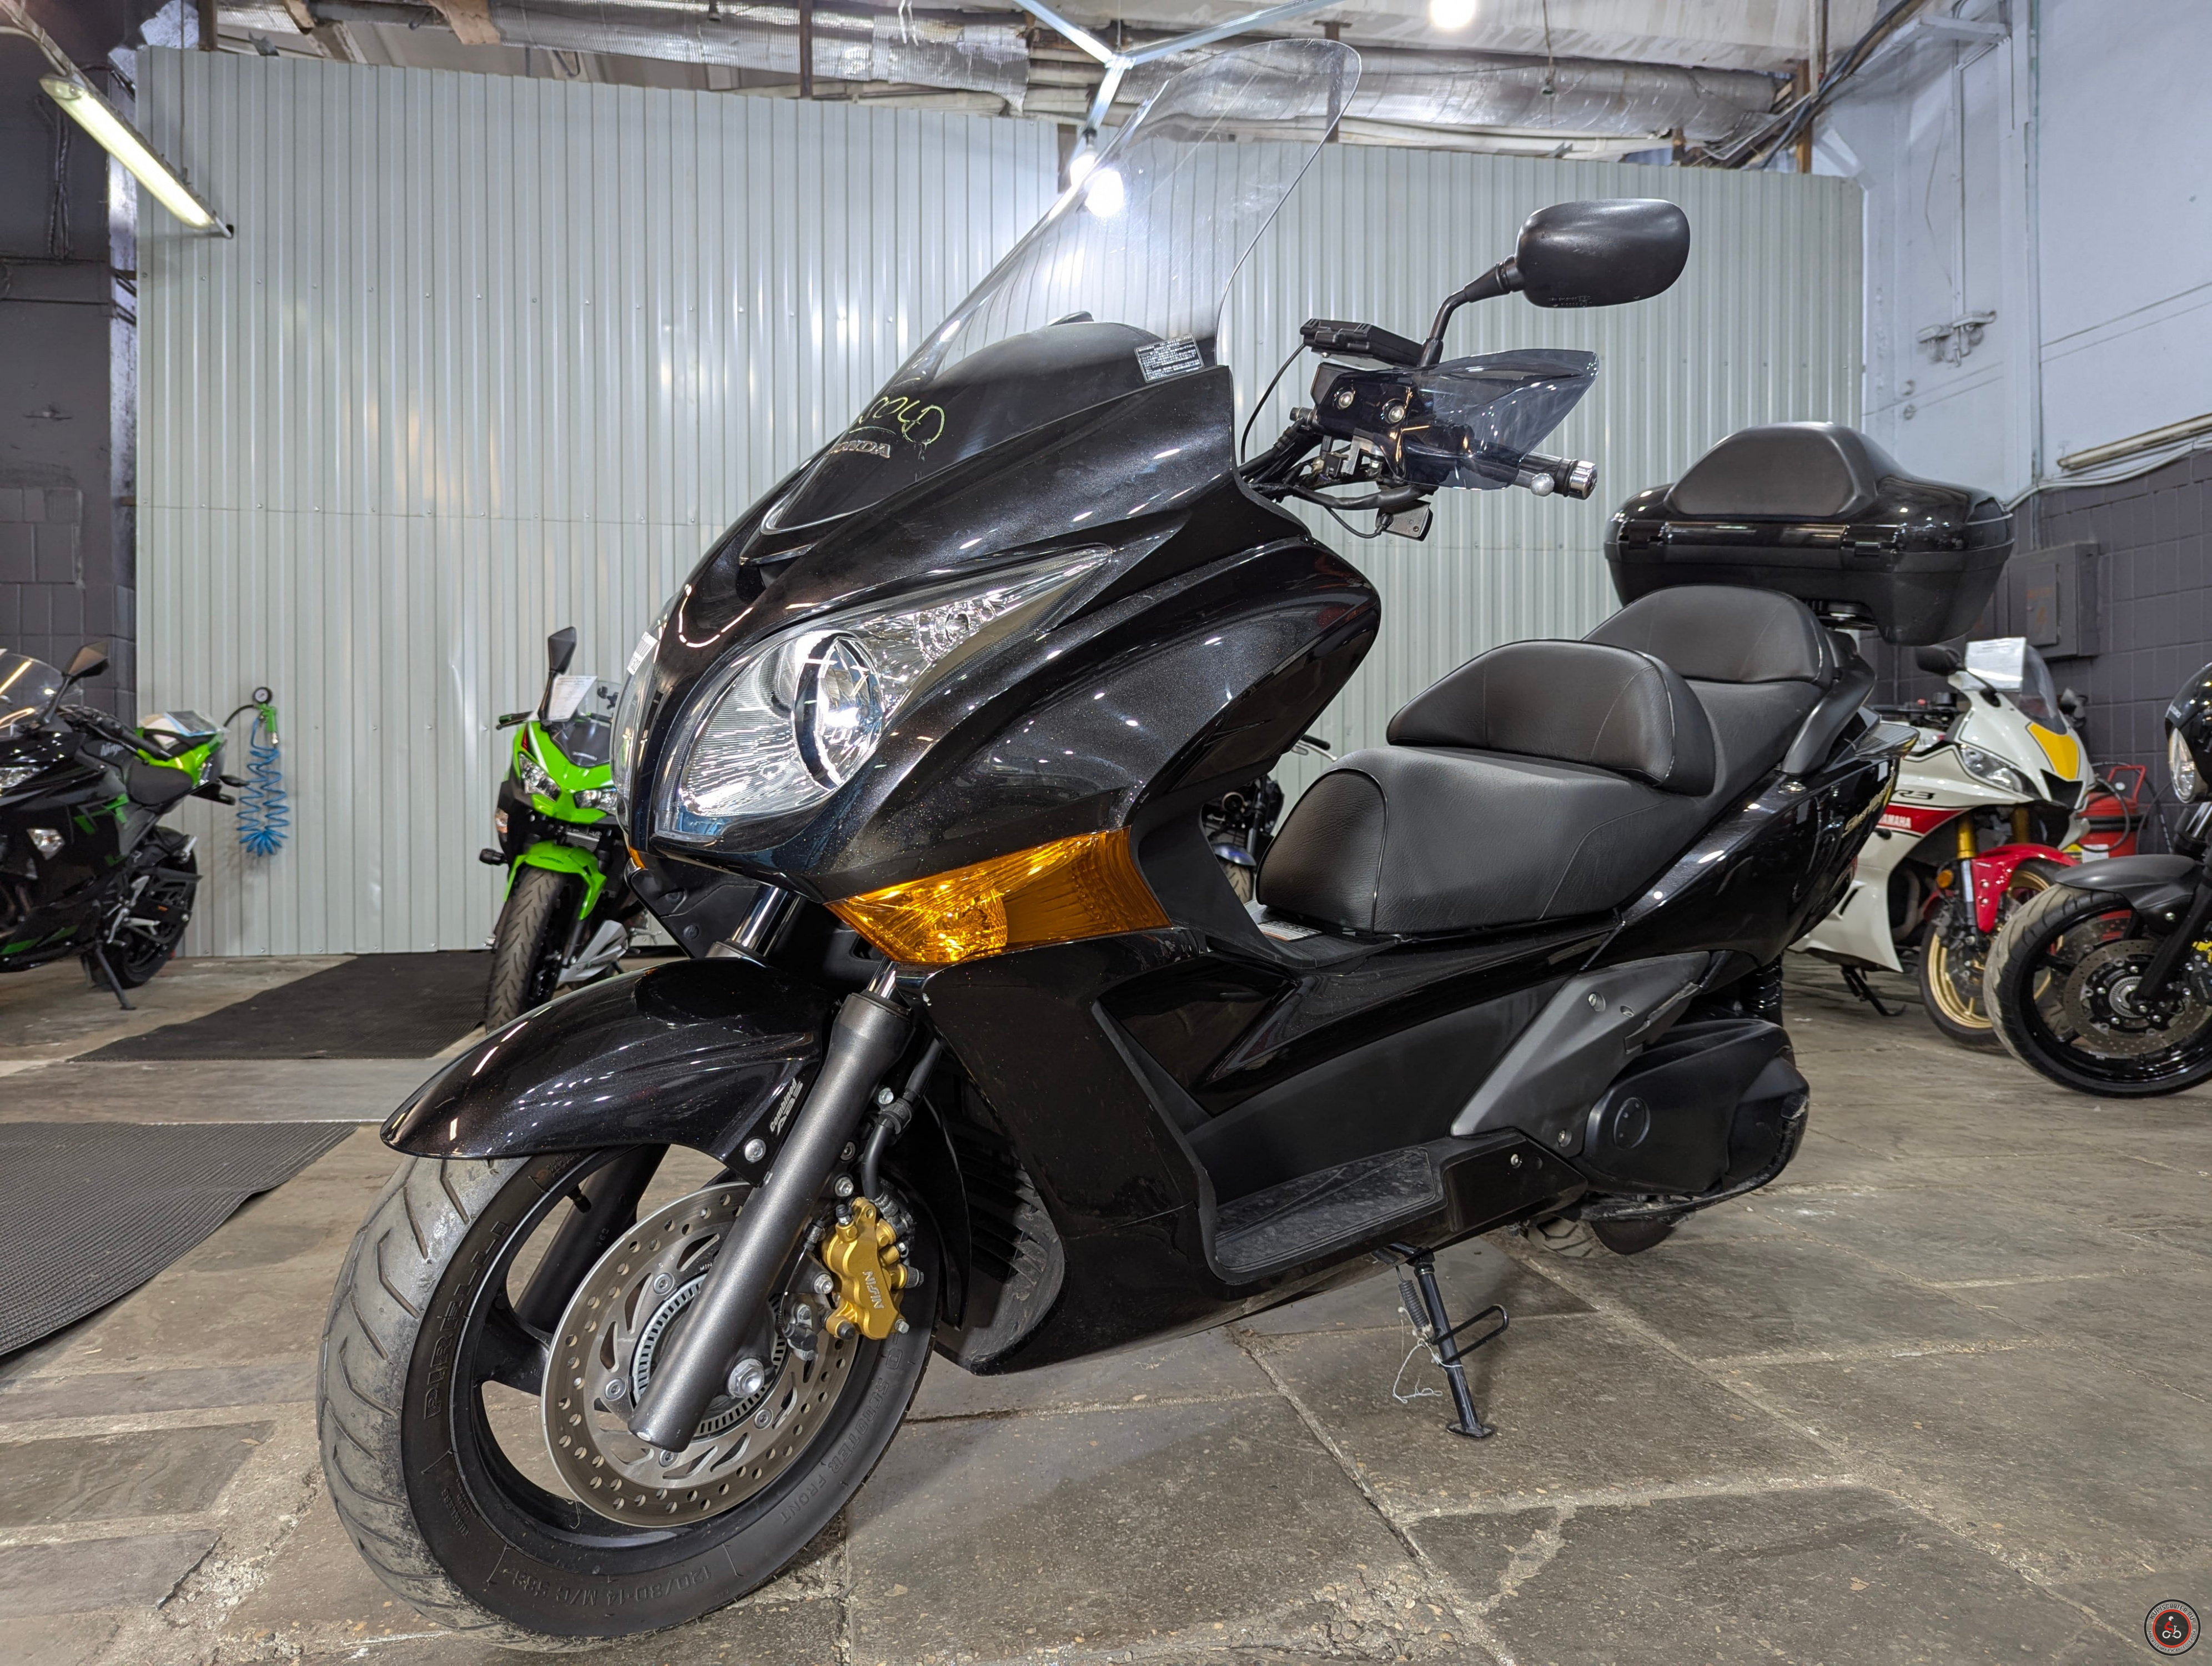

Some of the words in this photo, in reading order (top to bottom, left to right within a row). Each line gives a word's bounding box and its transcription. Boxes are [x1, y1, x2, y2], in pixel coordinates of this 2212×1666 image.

[1878, 814, 1912, 829] AMAHA
[770, 1077, 797, 1132] combined
[777, 1081, 803, 1136] ABS
[424, 1221, 509, 1419] PIRELLI
[827, 1377, 889, 1474] SCOOTER
[780, 1474, 827, 1524] FRONT
